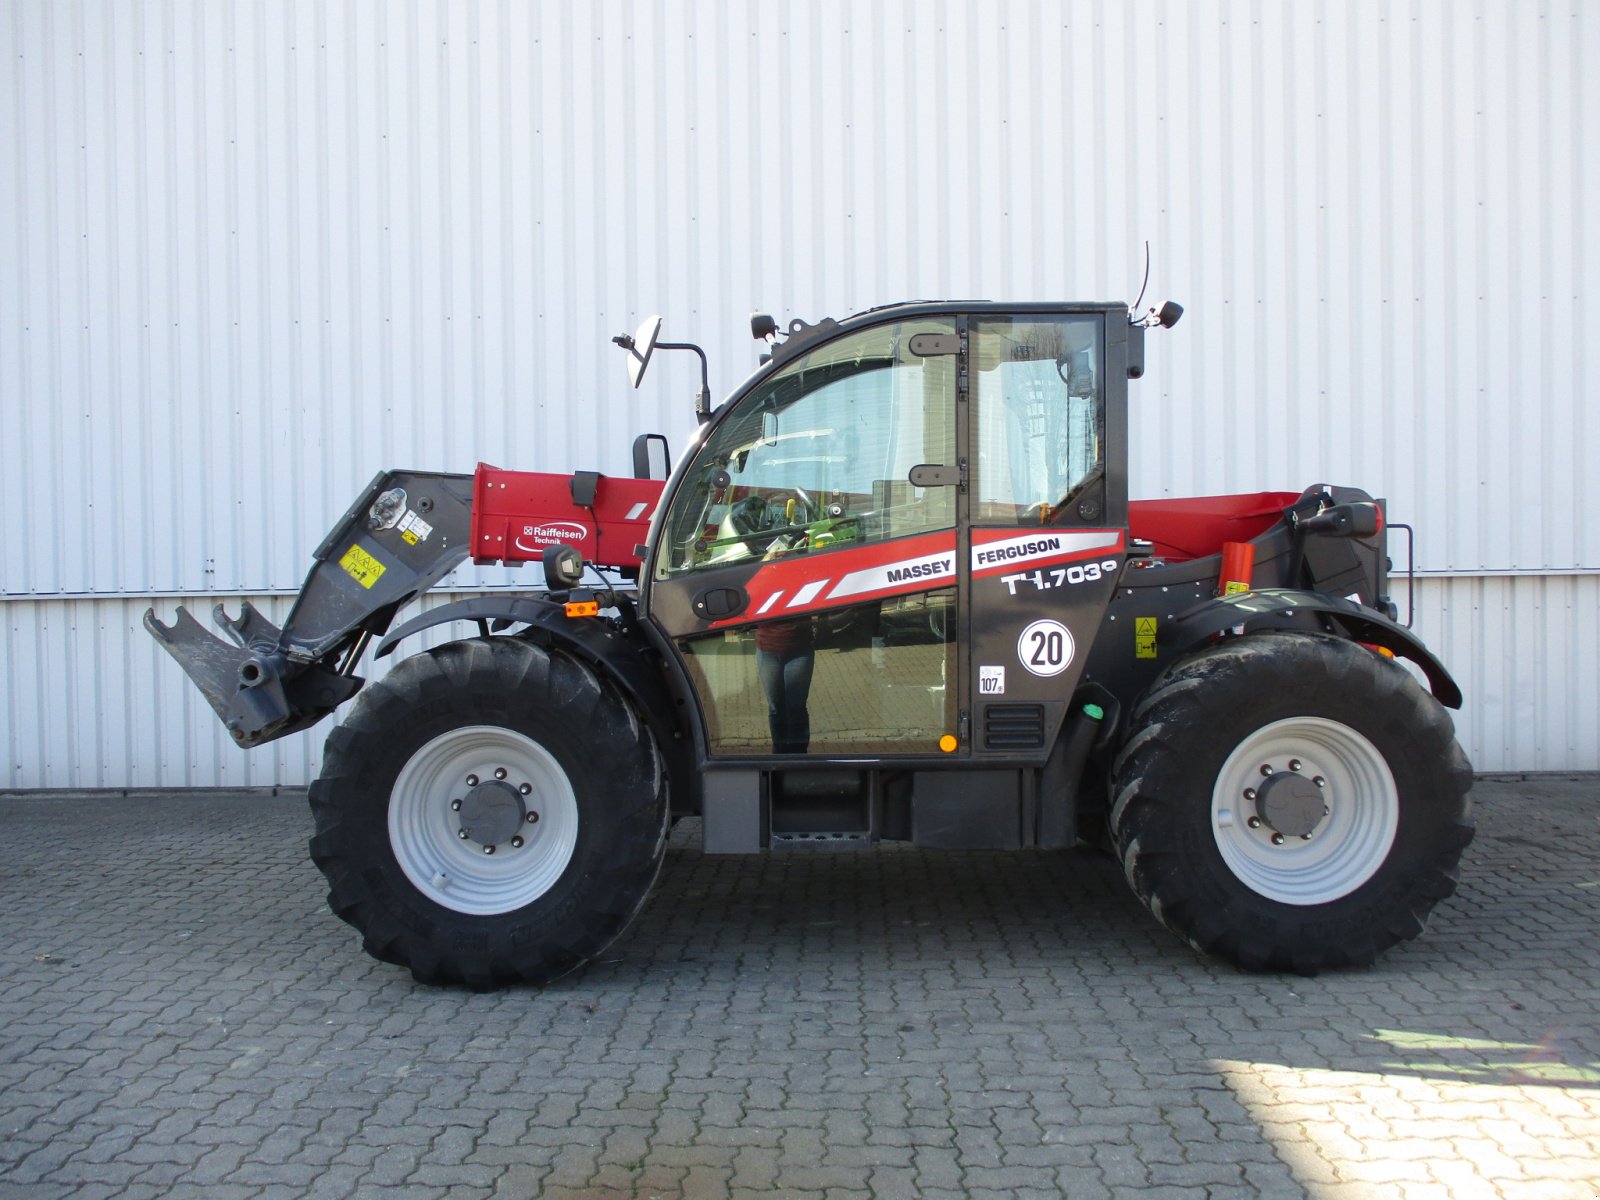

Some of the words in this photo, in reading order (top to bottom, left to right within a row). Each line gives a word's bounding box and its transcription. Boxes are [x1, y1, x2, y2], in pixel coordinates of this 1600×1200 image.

[534, 527, 582, 539] Raiffeisen
[534, 536, 561, 545] Technik
[887, 559, 951, 583] MASSEY
[977, 537, 1061, 565] FERGUSON
[1030, 631, 1063, 666] 20
[981, 678, 998, 692] 107
